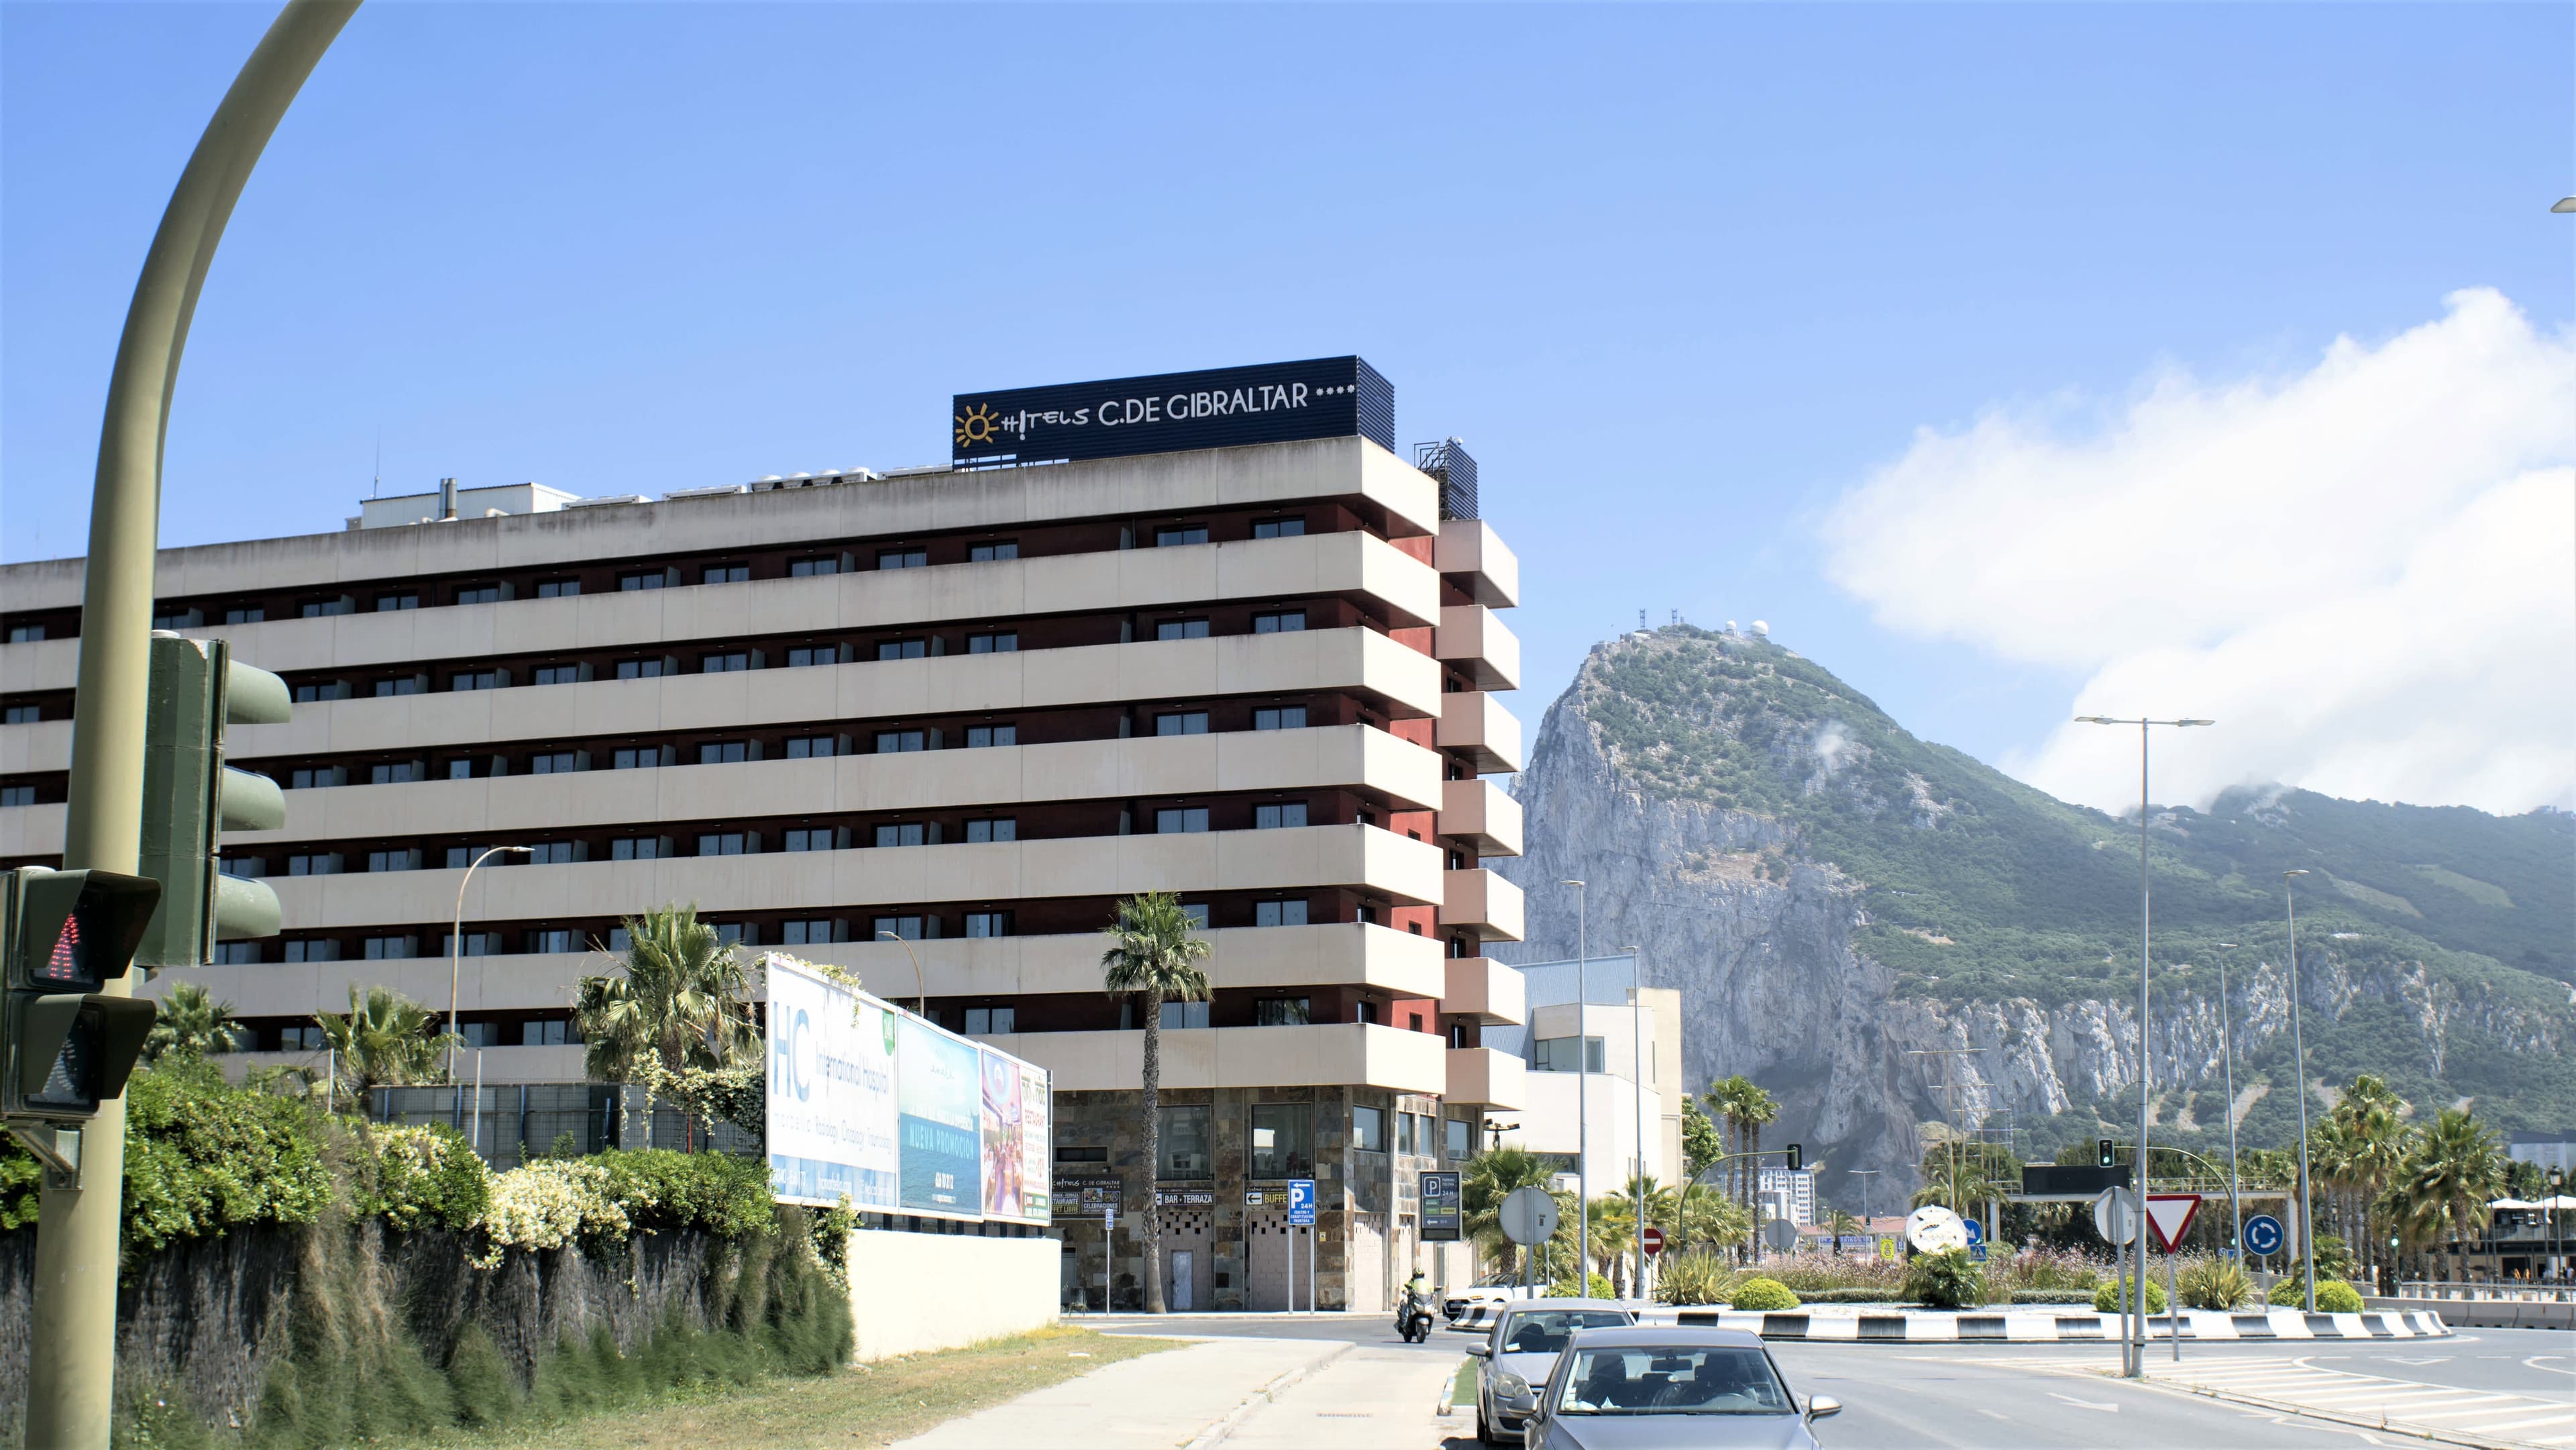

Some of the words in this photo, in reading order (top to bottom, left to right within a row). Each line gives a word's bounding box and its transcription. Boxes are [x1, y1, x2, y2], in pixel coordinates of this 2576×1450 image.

[1167, 382, 1308, 419] GIBRALTAR
[774, 1001, 810, 1102] HC
[816, 1041, 861, 1086] International
[863, 1056, 890, 1101] Hospital
[909, 1122, 934, 1151] NUEVA
[936, 1129, 974, 1159] PROMOCIÓN
[1165, 1195, 1178, 1204] BAR
[1183, 1194, 1212, 1203] TERRAZA
[1265, 1194, 1287, 1203] BUFFE
[1291, 1188, 1304, 1208] P
[1430, 1180, 1437, 1194] P
